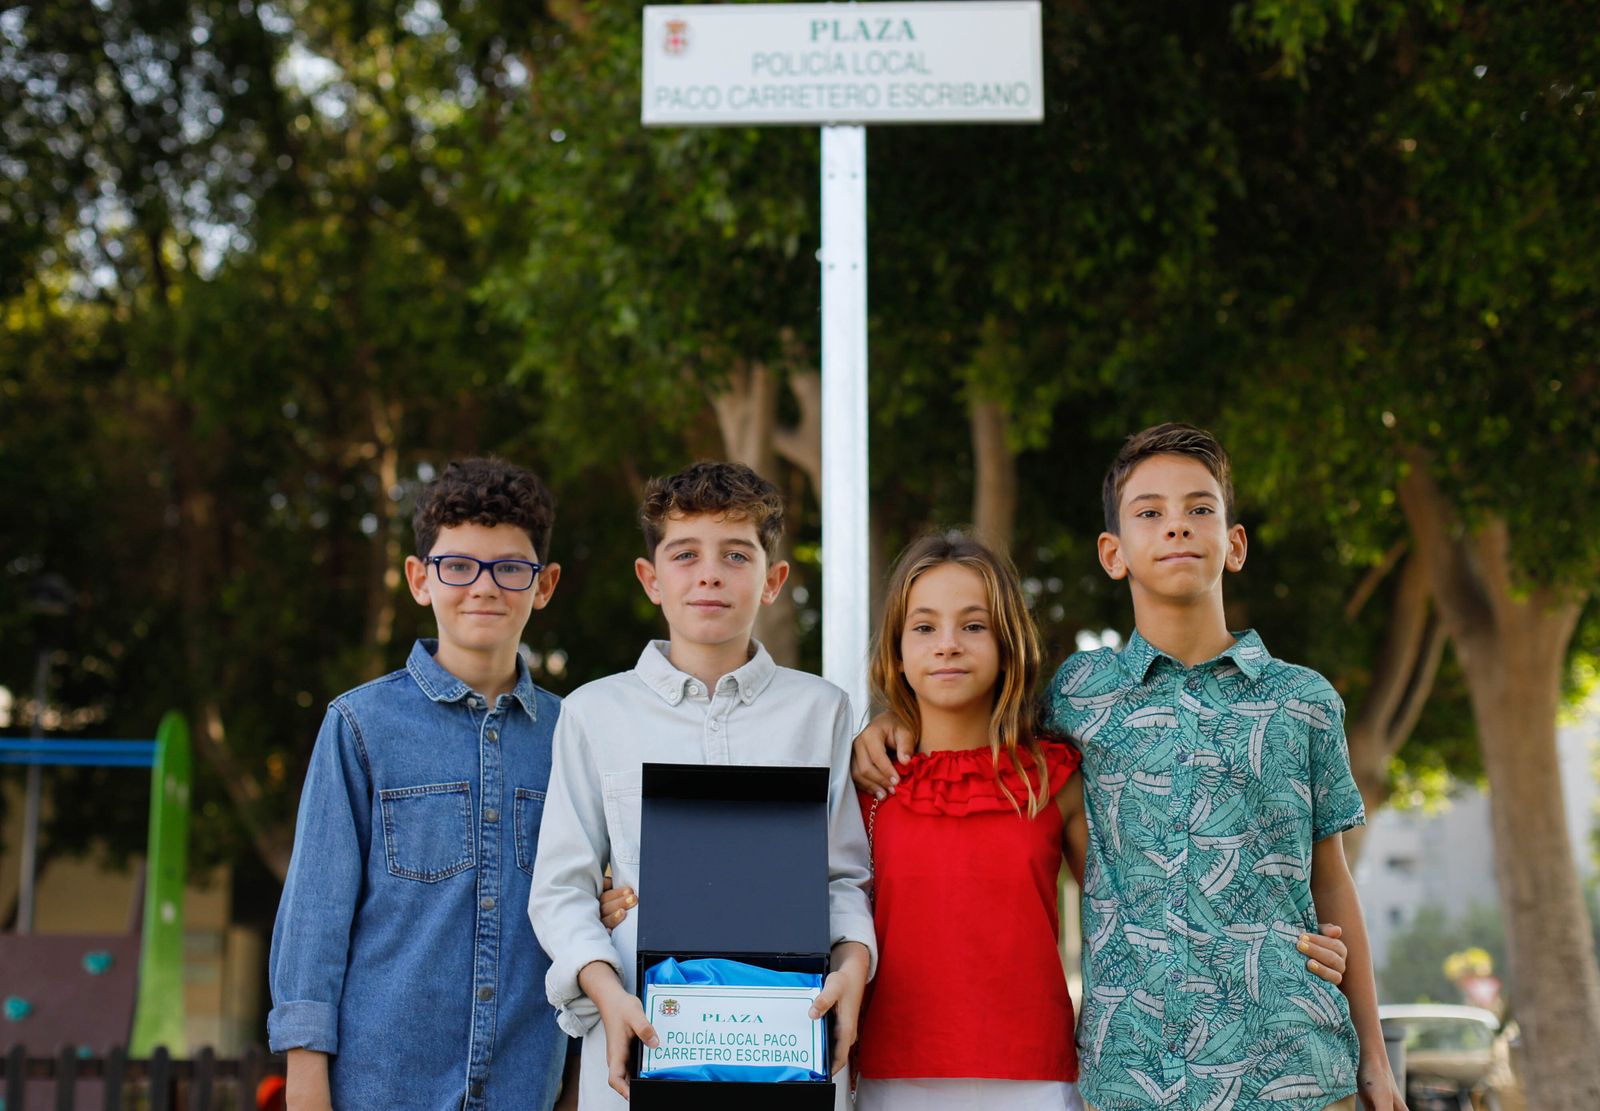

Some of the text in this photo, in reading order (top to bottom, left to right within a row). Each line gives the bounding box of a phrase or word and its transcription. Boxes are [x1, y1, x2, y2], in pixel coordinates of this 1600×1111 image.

[810, 19, 917, 42] PLAZA
[752, 49, 932, 76] POLICÍA LOCAL
[655, 81, 1031, 110] PACO CARRETERO ESCRIBANO
[702, 1013, 764, 1023] PLAZA
[667, 1030, 797, 1047] POLICÍA LOCAL PACO
[654, 1047, 809, 1063] CARRETERO ESCRIBANO
